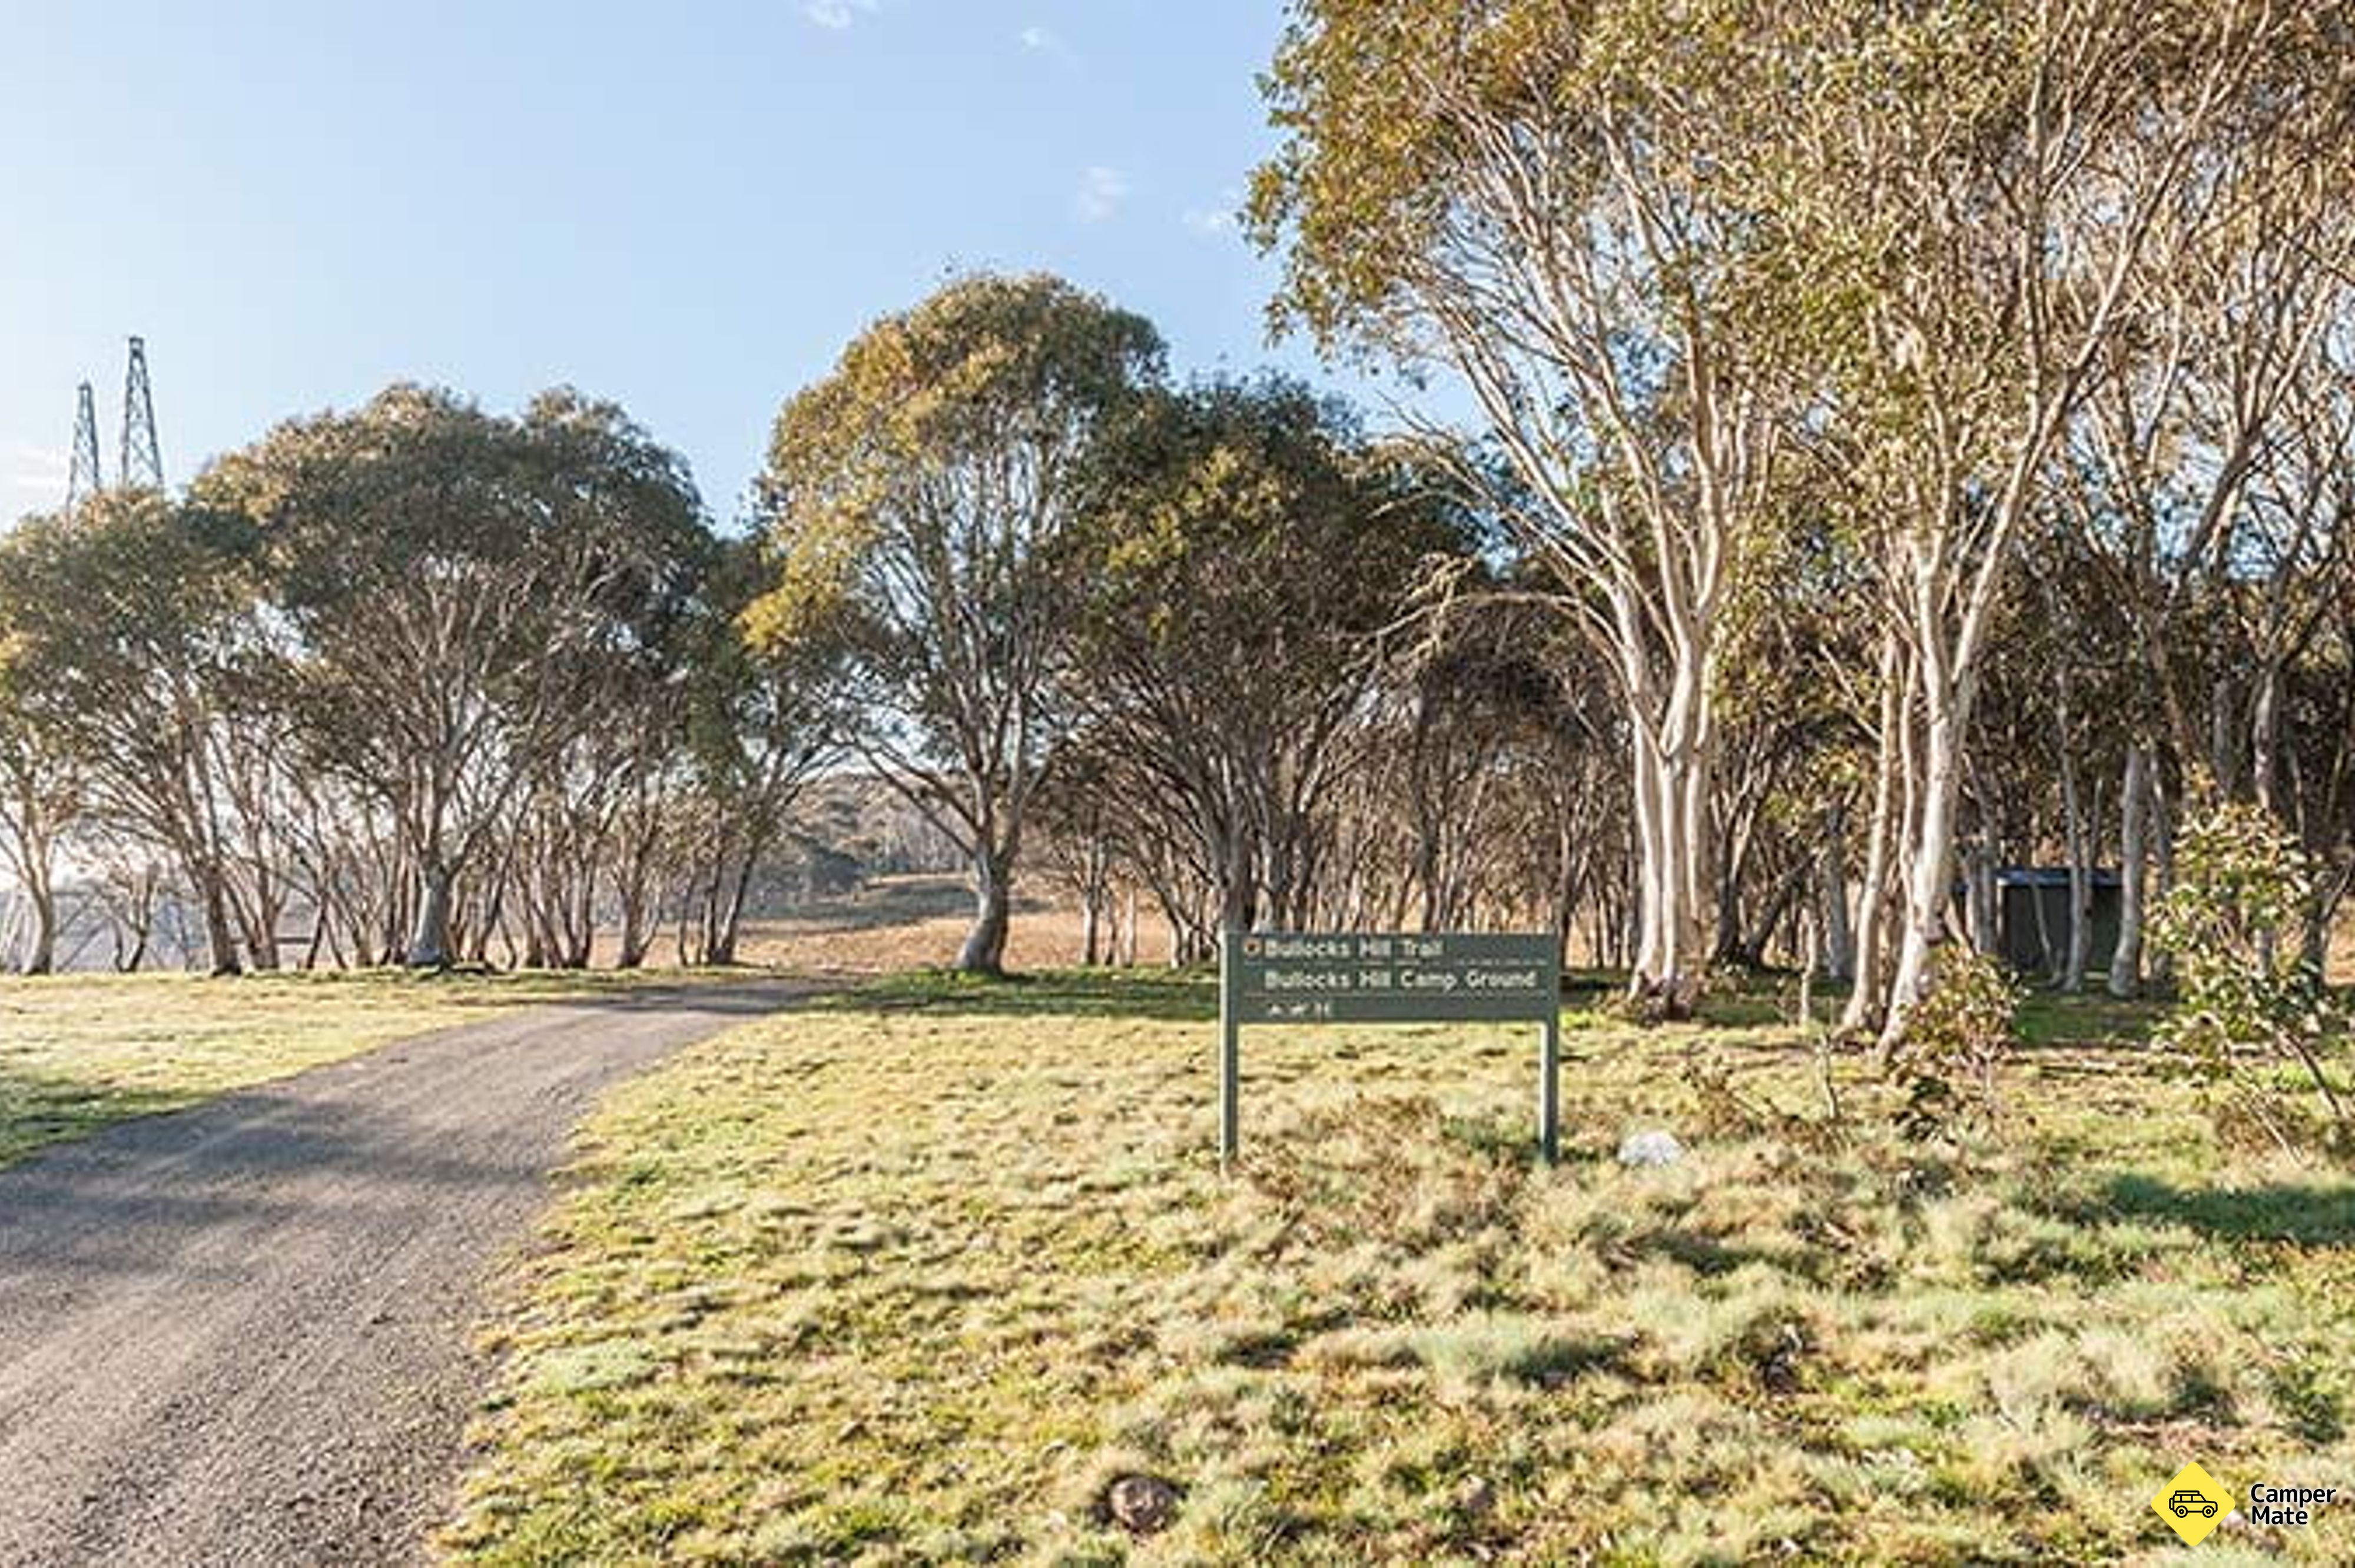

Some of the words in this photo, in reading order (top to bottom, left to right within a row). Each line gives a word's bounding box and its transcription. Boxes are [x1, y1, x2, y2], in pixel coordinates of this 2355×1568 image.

[1264, 940, 1351, 958] Bullocks
[1359, 940, 1391, 957] Hill
[1402, 940, 1444, 957] Trail
[1264, 971, 1351, 988] Bullocks
[1359, 971, 1391, 988] Hill
[1400, 971, 1457, 991] Camp
[1466, 970, 1537, 988] Ground
